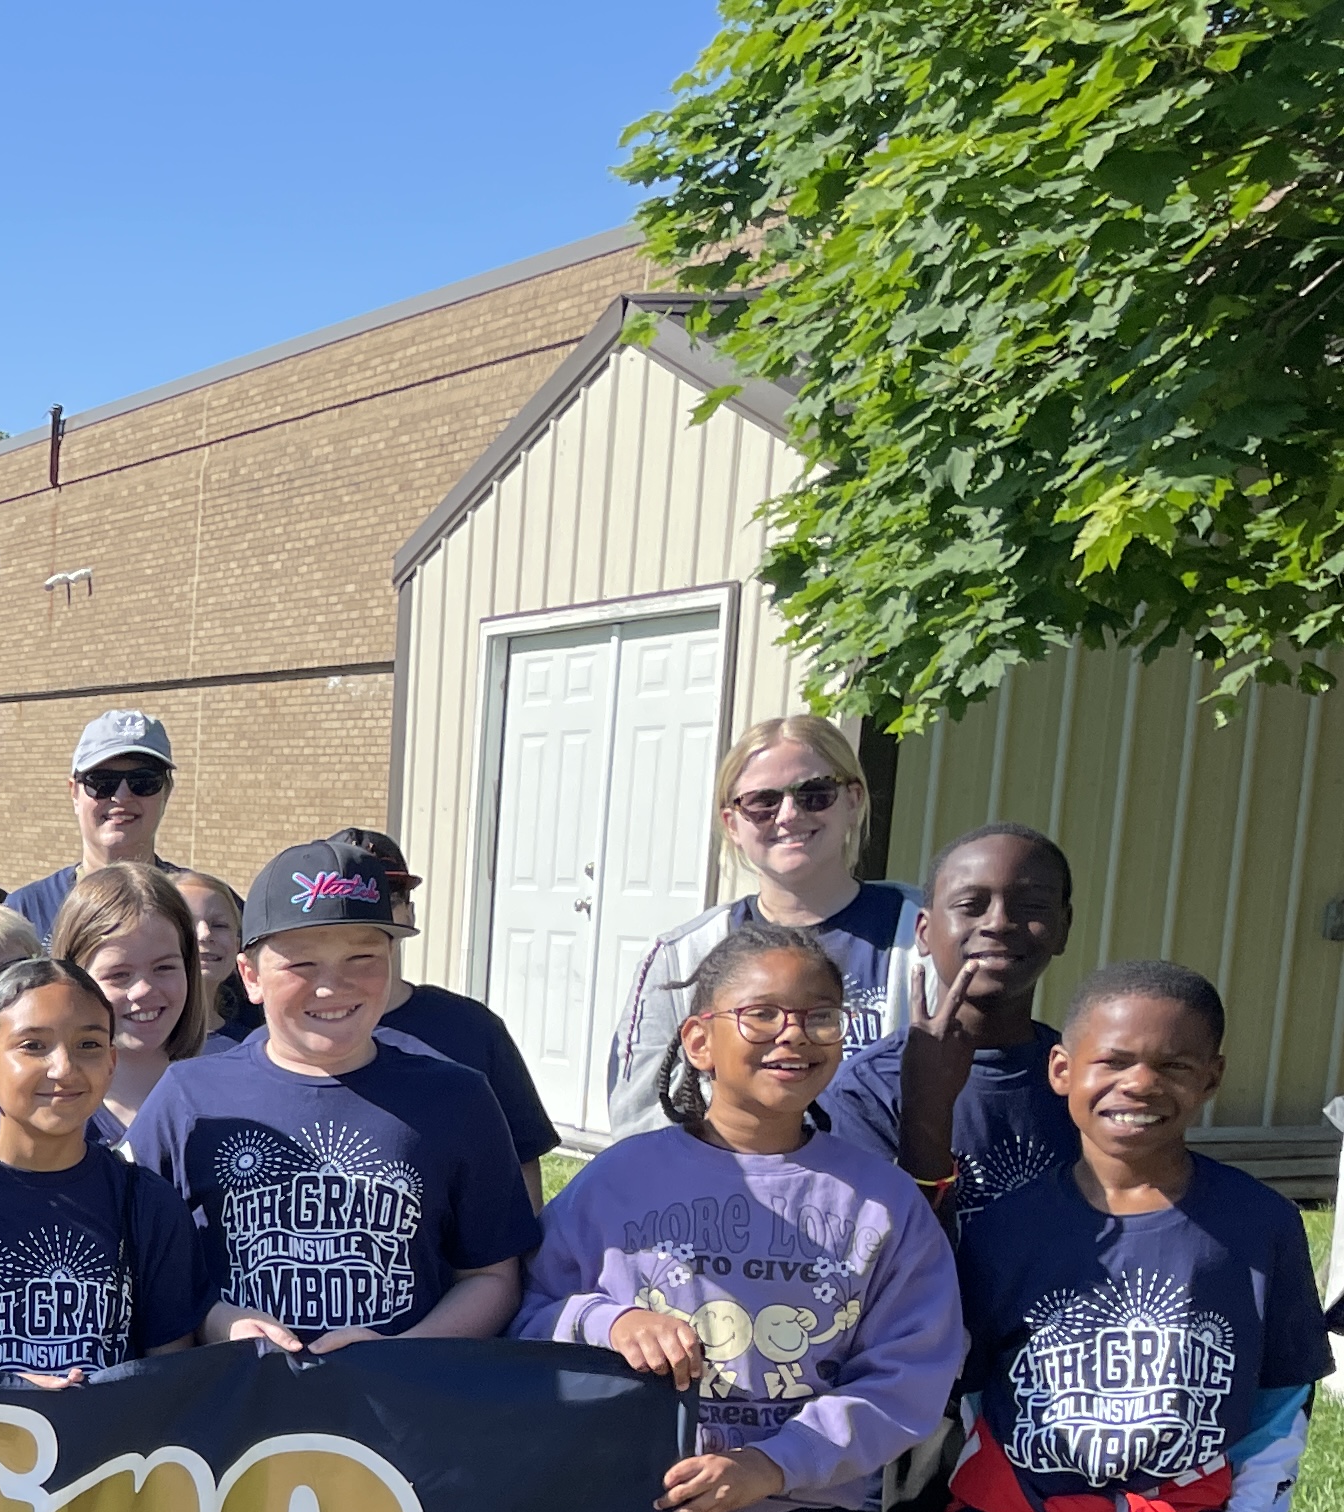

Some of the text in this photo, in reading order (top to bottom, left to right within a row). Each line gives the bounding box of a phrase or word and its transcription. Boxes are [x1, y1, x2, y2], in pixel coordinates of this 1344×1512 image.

[221, 1171, 422, 1241] 4TH GRADE
[220, 1265, 415, 1330] JAMBOREE
[694, 1255, 732, 1275] TO
[26, 1277, 134, 1340] GRA
[1008, 1325, 1236, 1397] 4TH GRADE
